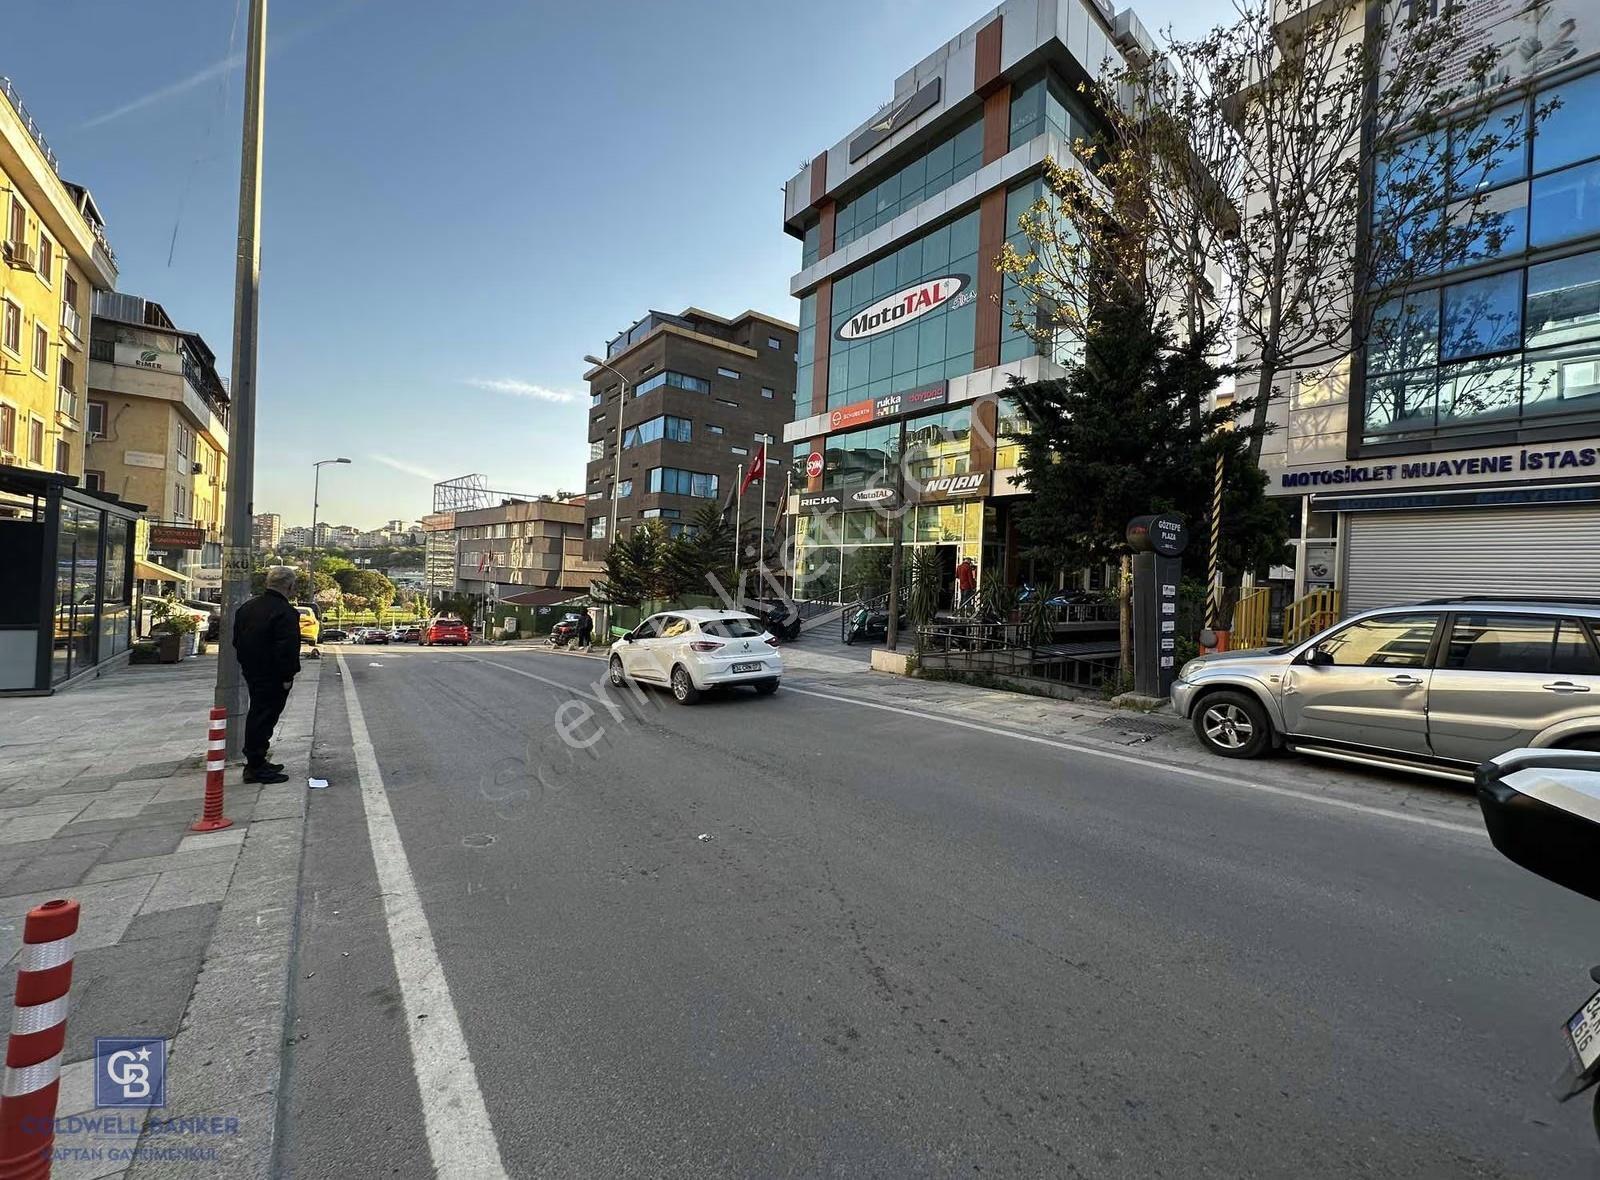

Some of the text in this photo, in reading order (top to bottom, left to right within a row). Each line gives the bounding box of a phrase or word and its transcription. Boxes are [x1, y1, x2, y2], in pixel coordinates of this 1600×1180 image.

[850, 282, 946, 337] MotoTAL
[876, 395, 902, 409] rukka
[1282, 448, 1600, 487] MOTOSİKLET MUAYENE İSTAS
[925, 474, 984, 496] NOLAN
[801, 496, 840, 507] RICHA
[1158, 520, 1181, 532] GÖZTEPE
[1161, 531, 1176, 541] PLAZA
[224, 558, 250, 570] AKÜ
